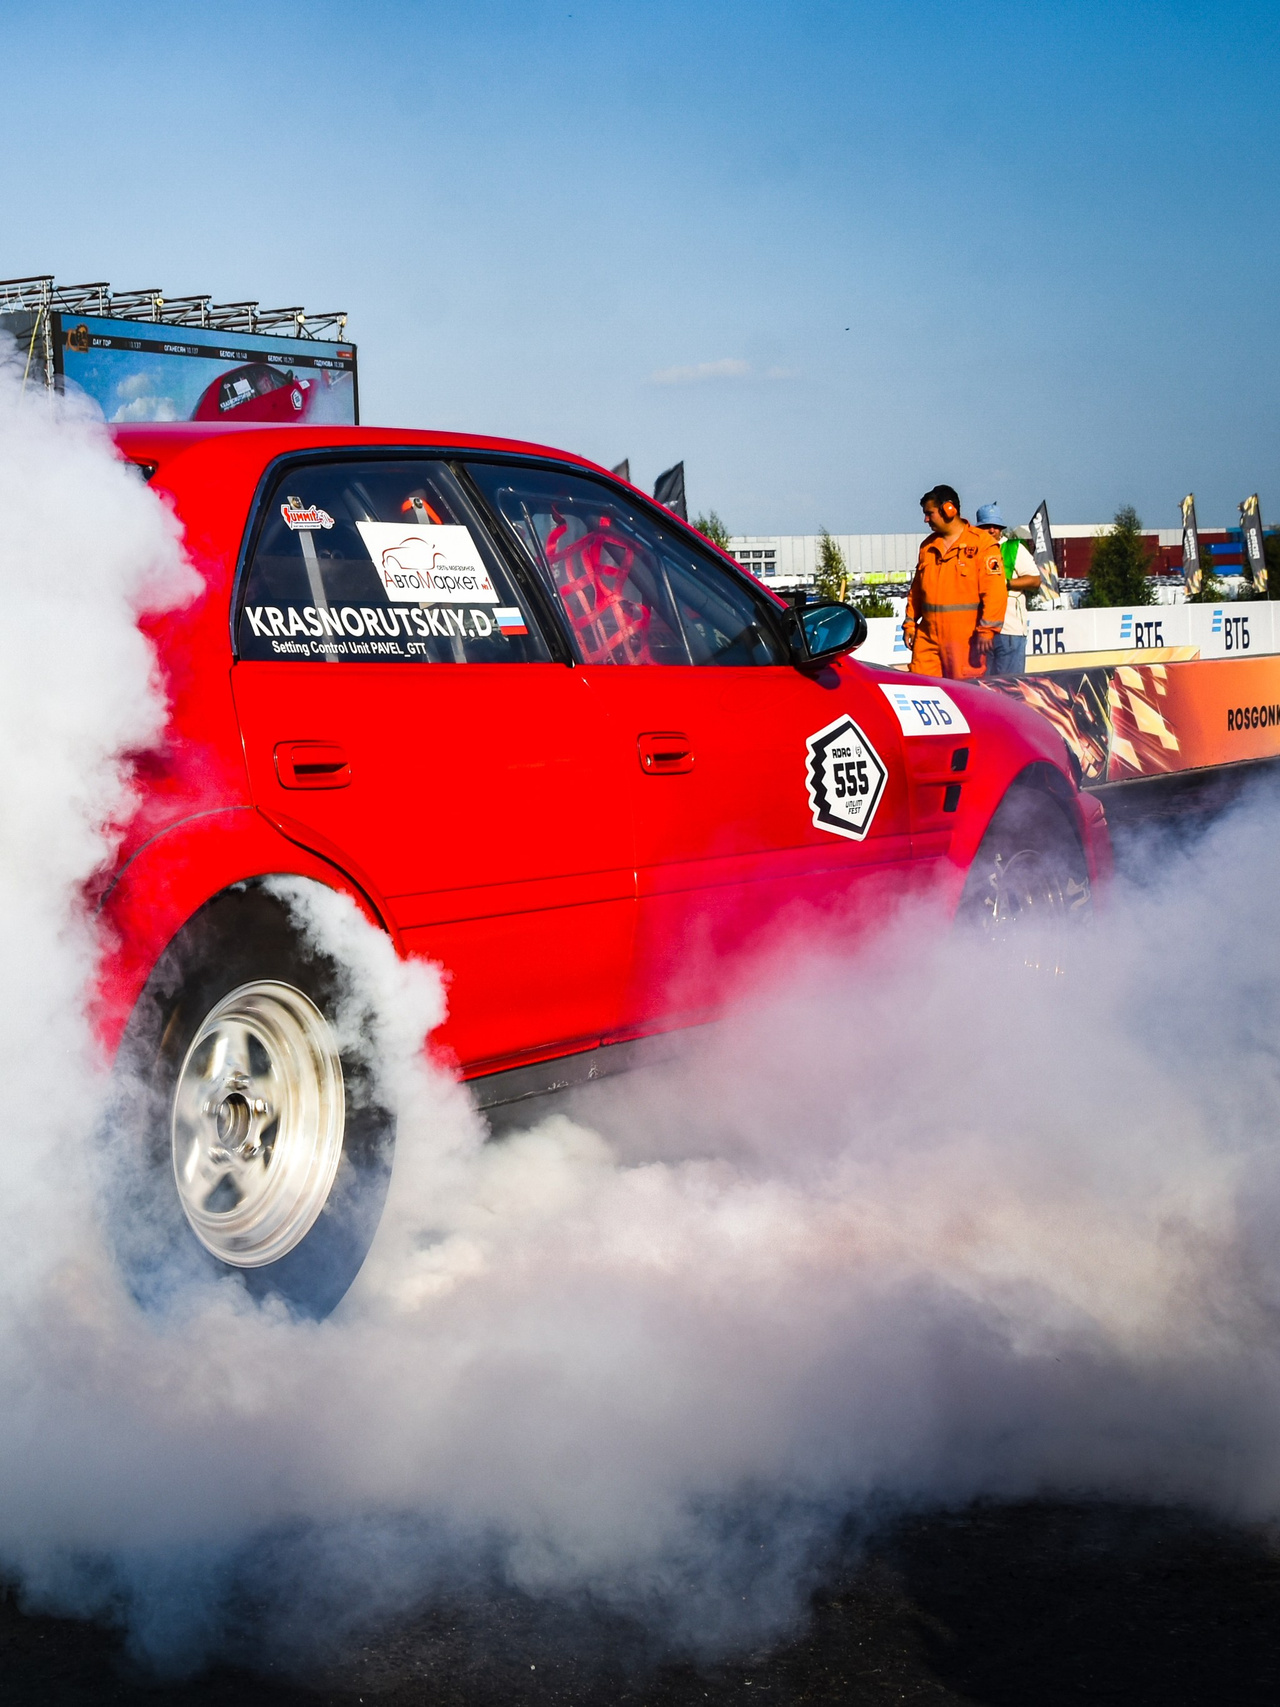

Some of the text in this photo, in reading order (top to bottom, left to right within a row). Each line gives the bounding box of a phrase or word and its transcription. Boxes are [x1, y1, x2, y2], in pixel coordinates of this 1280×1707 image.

[92, 338, 112, 347] DAY TOP
[283, 507, 317, 524] SUMMIT
[384, 570, 479, 594] АвтоМаркет
[245, 606, 492, 637] KRASNORUTSKIY.D
[1225, 617, 1250, 650] ВТБ
[271, 640, 427, 657] Setting Control Unit PAVEL_GTT
[911, 700, 952, 725] ВТБ
[832, 747, 852, 758] RDRC
[833, 760, 869, 798] 555
[848, 807, 861, 815] FEST
